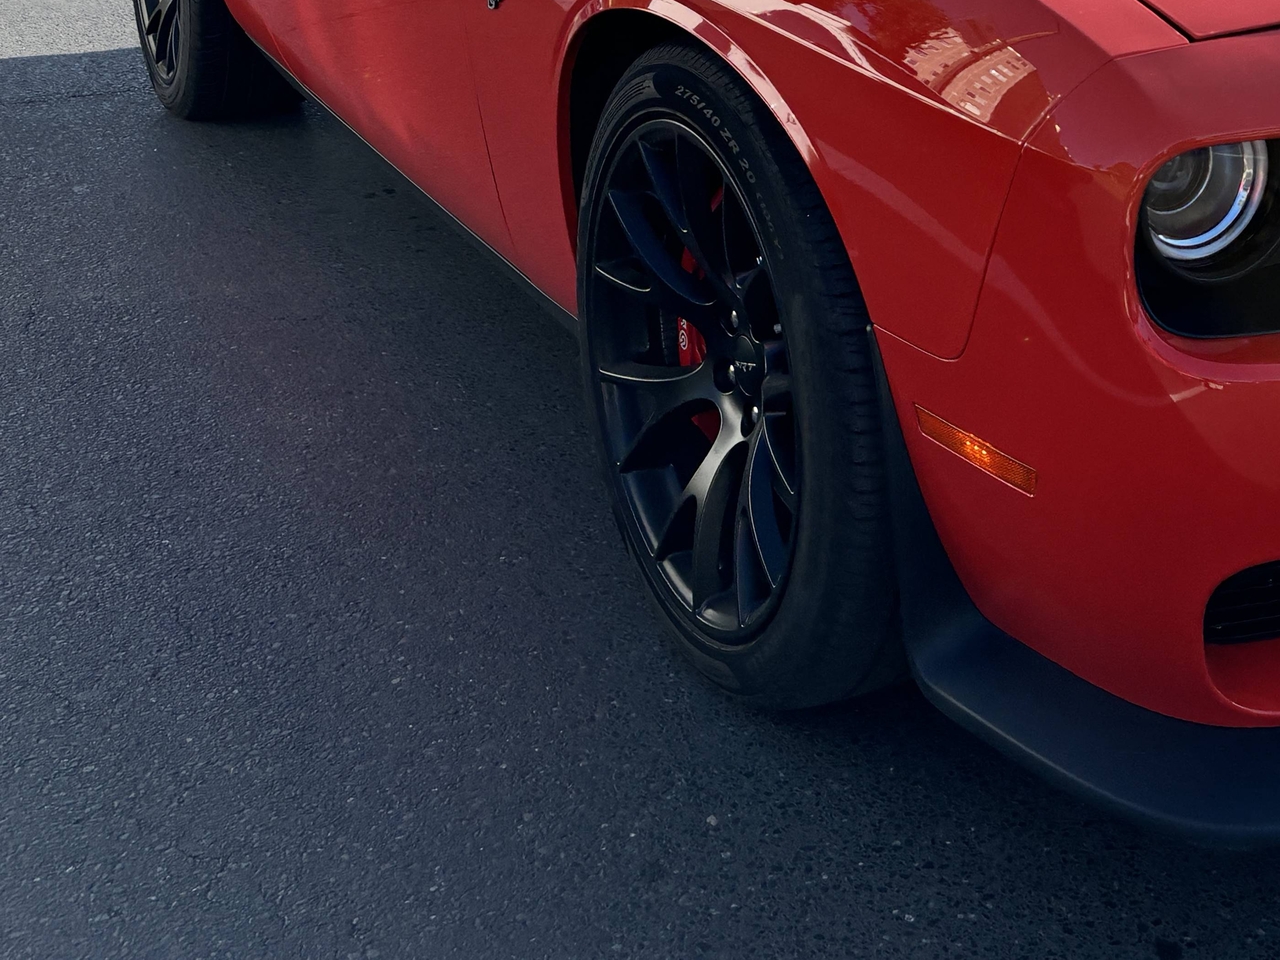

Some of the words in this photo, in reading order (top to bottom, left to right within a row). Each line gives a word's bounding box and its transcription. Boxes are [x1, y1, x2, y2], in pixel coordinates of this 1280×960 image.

[674, 85, 721, 127] 275/40
[720, 127, 740, 155] ZR
[738, 158, 756, 184] 20
